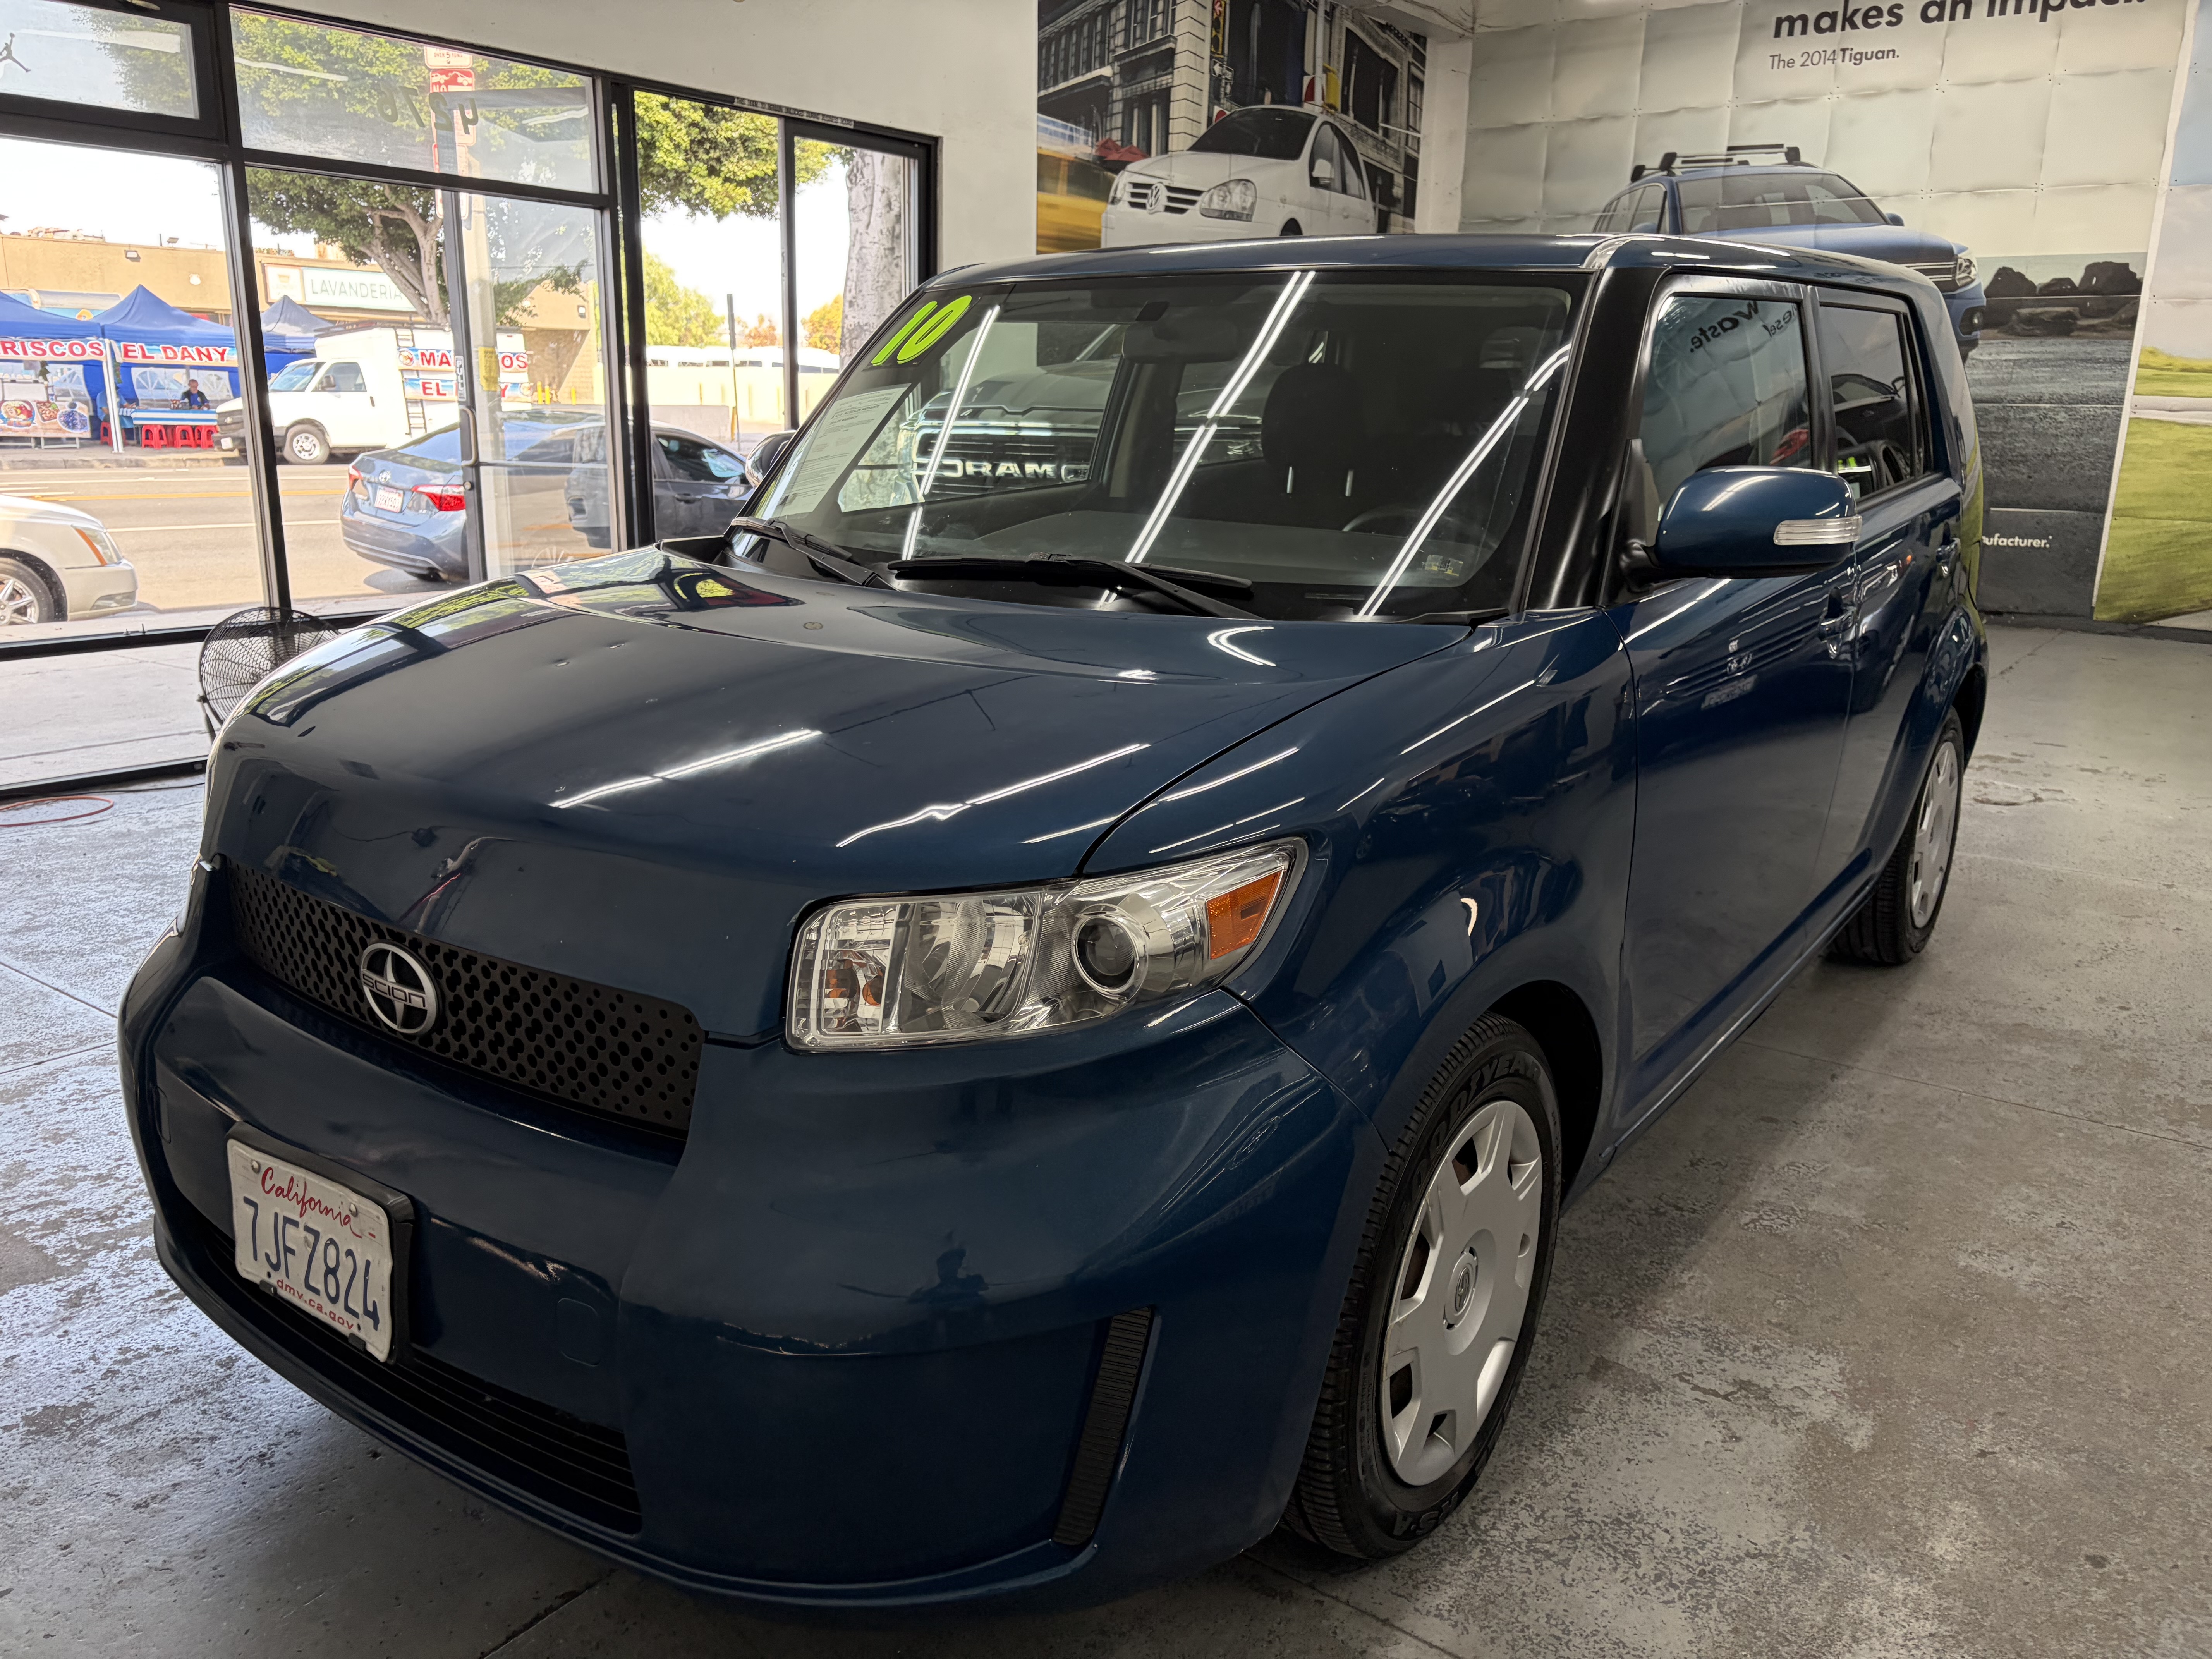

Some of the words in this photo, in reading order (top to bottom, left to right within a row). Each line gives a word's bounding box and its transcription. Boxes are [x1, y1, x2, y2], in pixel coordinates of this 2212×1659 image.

[1774, 0, 1904, 38] makes
[1920, 0, 1973, 24] an
[1769, 53, 1795, 70] The
[1800, 49, 1837, 68] 2014
[1840, 47, 1900, 66] Tiguan.
[311, 278, 403, 300] LAVANDERIA
[871, 295, 972, 366] 10
[123, 343, 155, 359] EL
[161, 345, 227, 362] DANY
[421, 381, 447, 396] EL
[965, 461, 1056, 479] RAM
[261, 1166, 362, 1238] California
[243, 1196, 380, 1331] 7JFZ824
[276, 1279, 354, 1330] dmv.ca.gov
